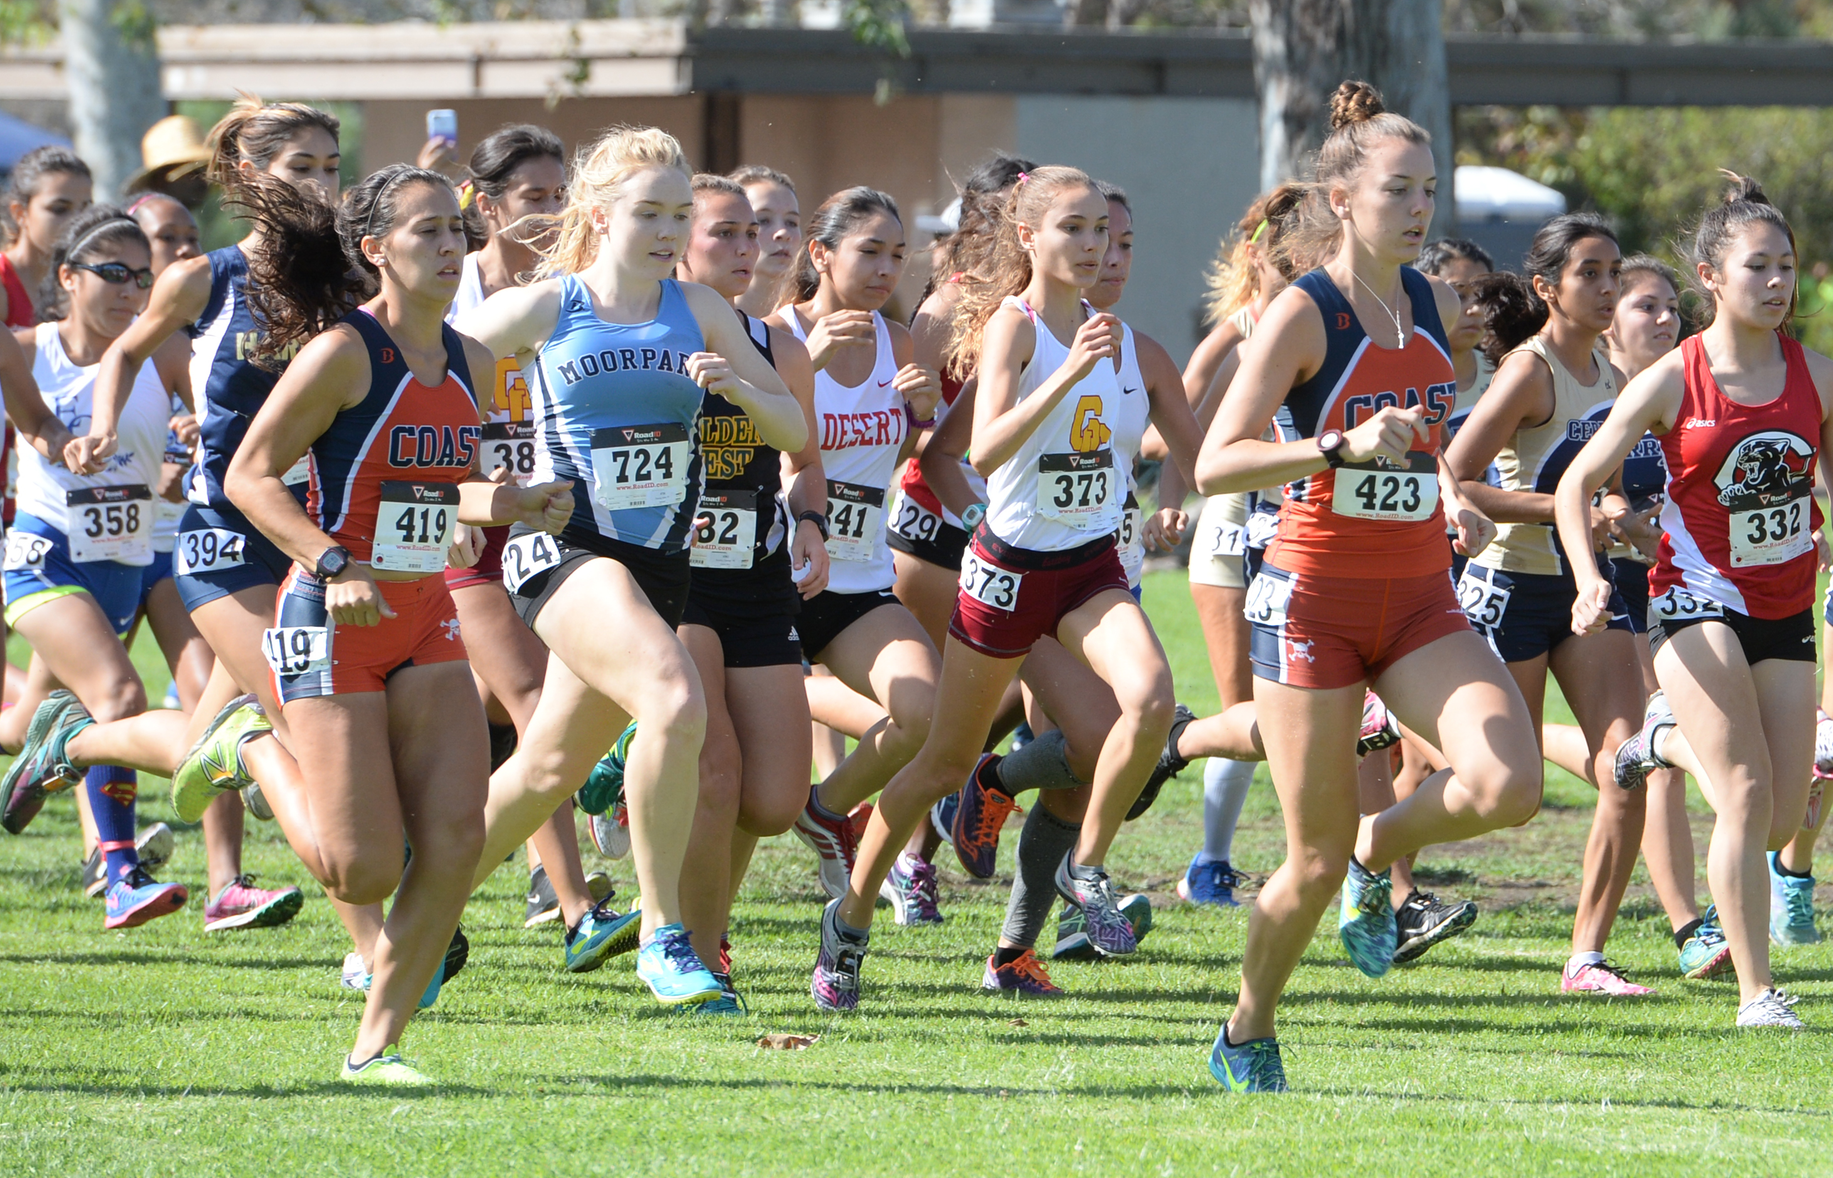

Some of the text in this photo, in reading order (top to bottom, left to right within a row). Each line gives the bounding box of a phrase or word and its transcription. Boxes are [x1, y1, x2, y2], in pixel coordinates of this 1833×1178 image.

[820, 408, 902, 450] DESERT
[612, 446, 673, 483] 724
[616, 481, 669, 491] www.RoadID.com
[1053, 472, 1107, 508] 373
[1355, 474, 1421, 513] 423
[84, 503, 140, 538] 358
[396, 507, 447, 544] 419
[1747, 503, 1801, 544] 332
[187, 533, 241, 569] 394
[965, 558, 1016, 607] 373
